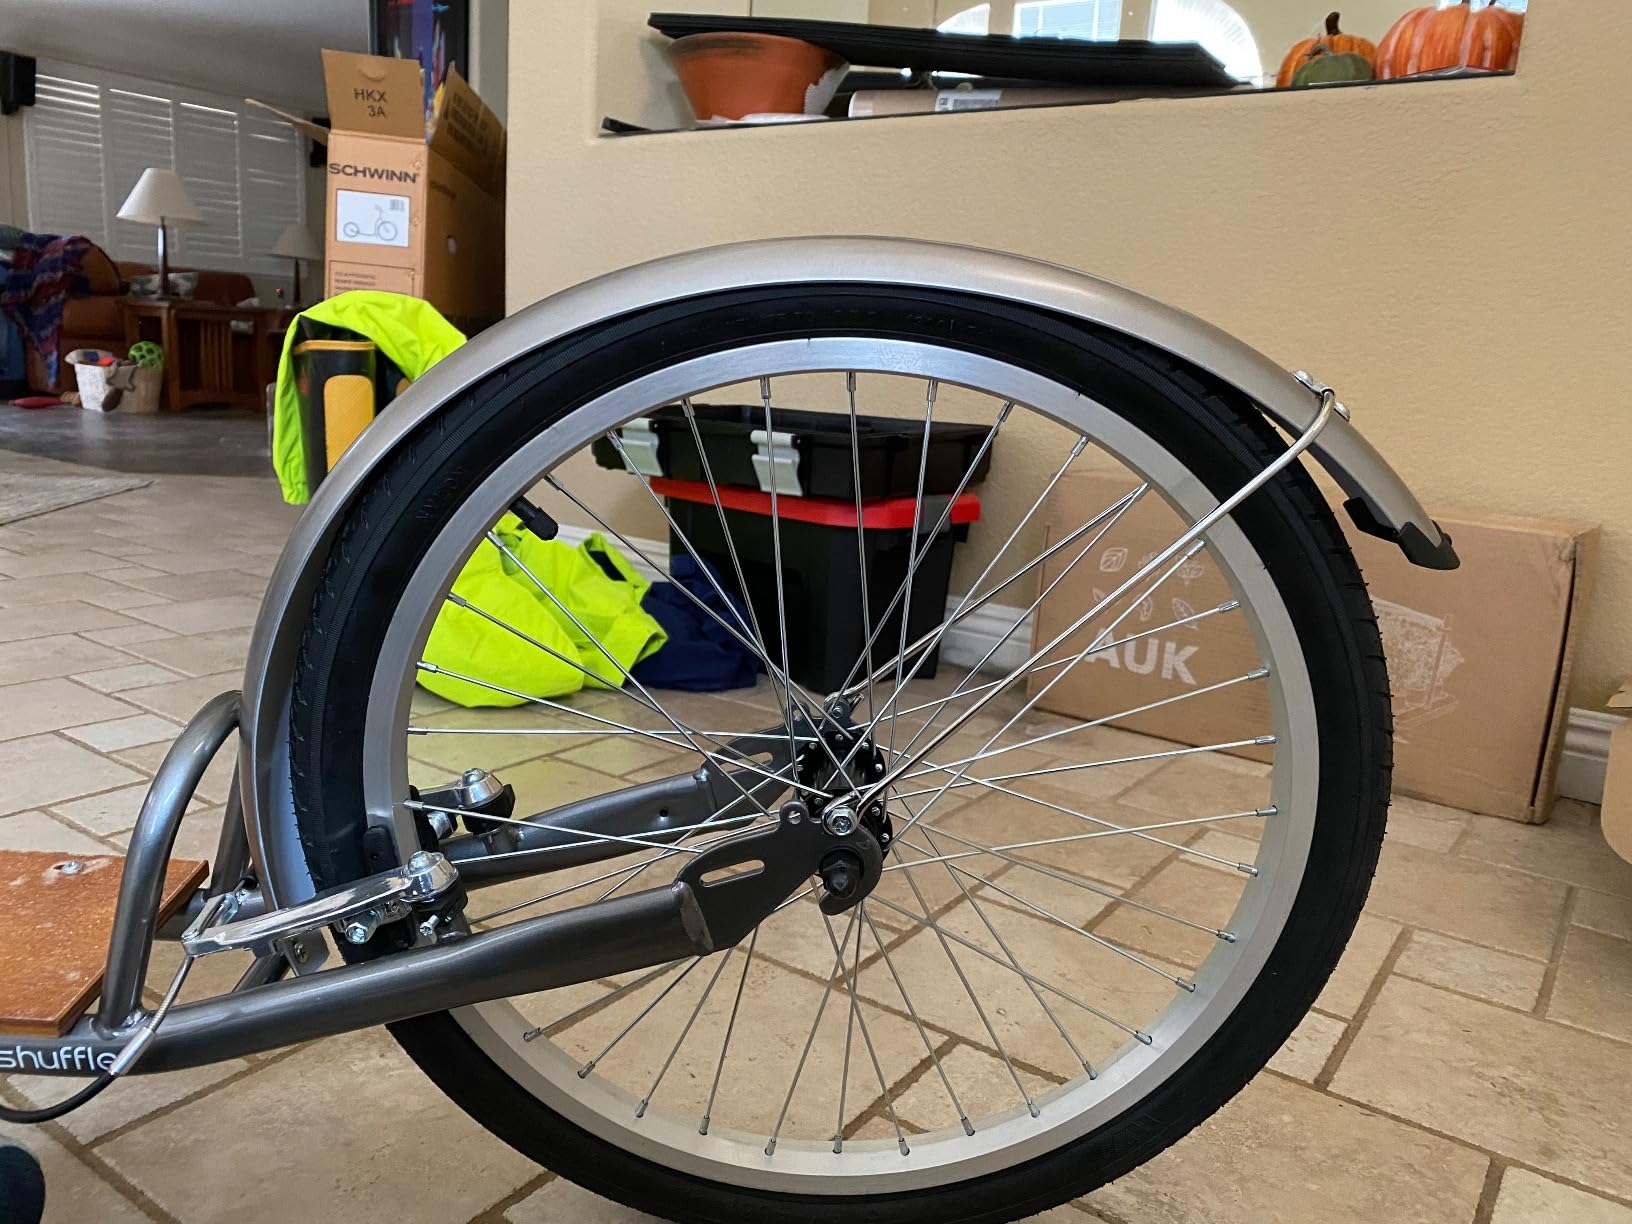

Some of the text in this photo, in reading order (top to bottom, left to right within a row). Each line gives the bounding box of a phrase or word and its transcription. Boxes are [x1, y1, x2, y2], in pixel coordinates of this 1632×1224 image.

[353, 87, 387, 103] HKX
[367, 105, 386, 118] 3A
[328, 162, 418, 184] SCHWINN
[1083, 627, 1199, 686] AUK
[0, 1045, 117, 1071] shuffle
